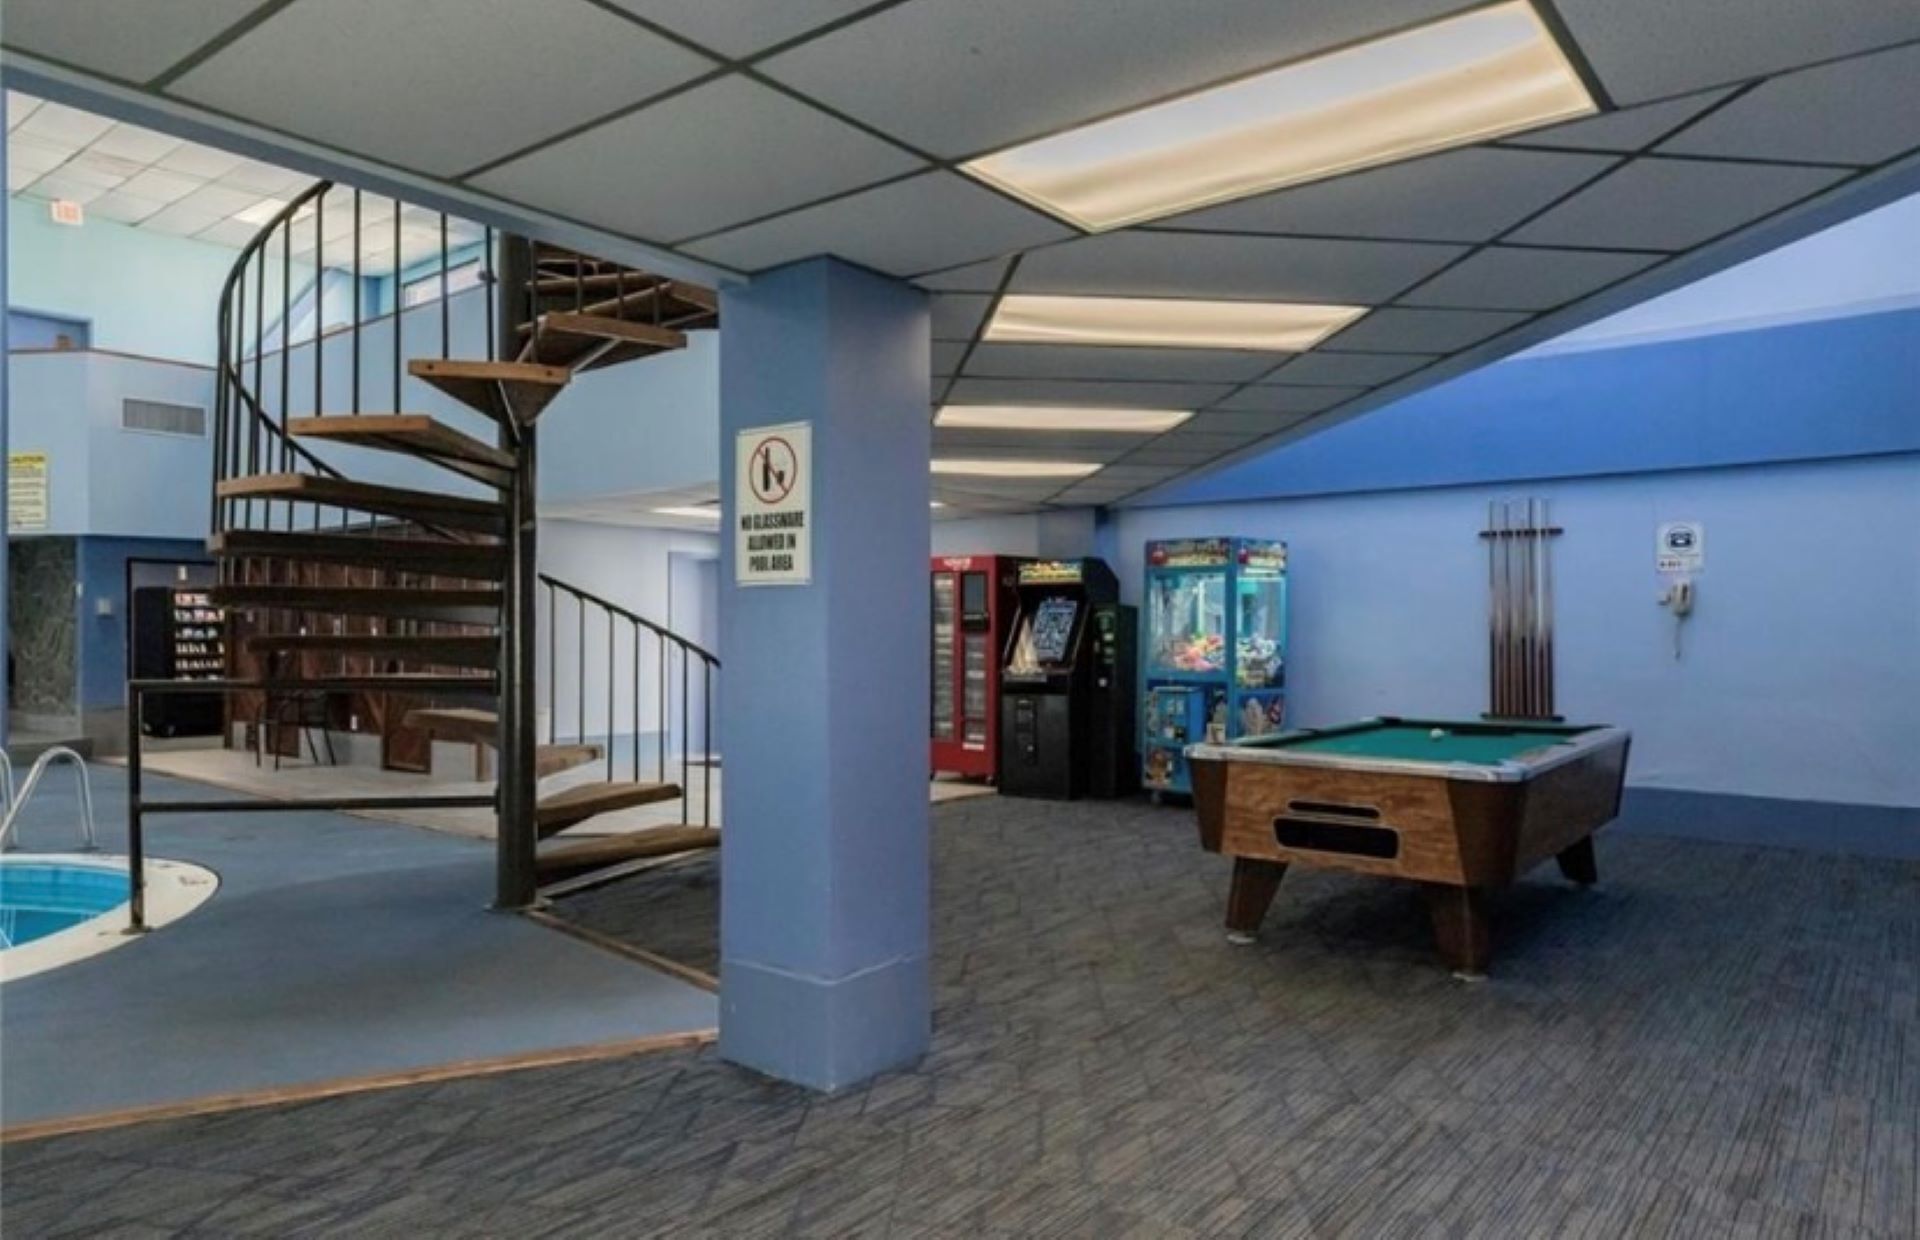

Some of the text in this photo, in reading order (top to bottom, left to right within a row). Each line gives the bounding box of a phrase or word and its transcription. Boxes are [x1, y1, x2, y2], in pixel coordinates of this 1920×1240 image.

[741, 510, 804, 531] NO GLASSWARE
[747, 532, 797, 551] ALLOWED IN
[749, 553, 795, 573] POOL AREA
